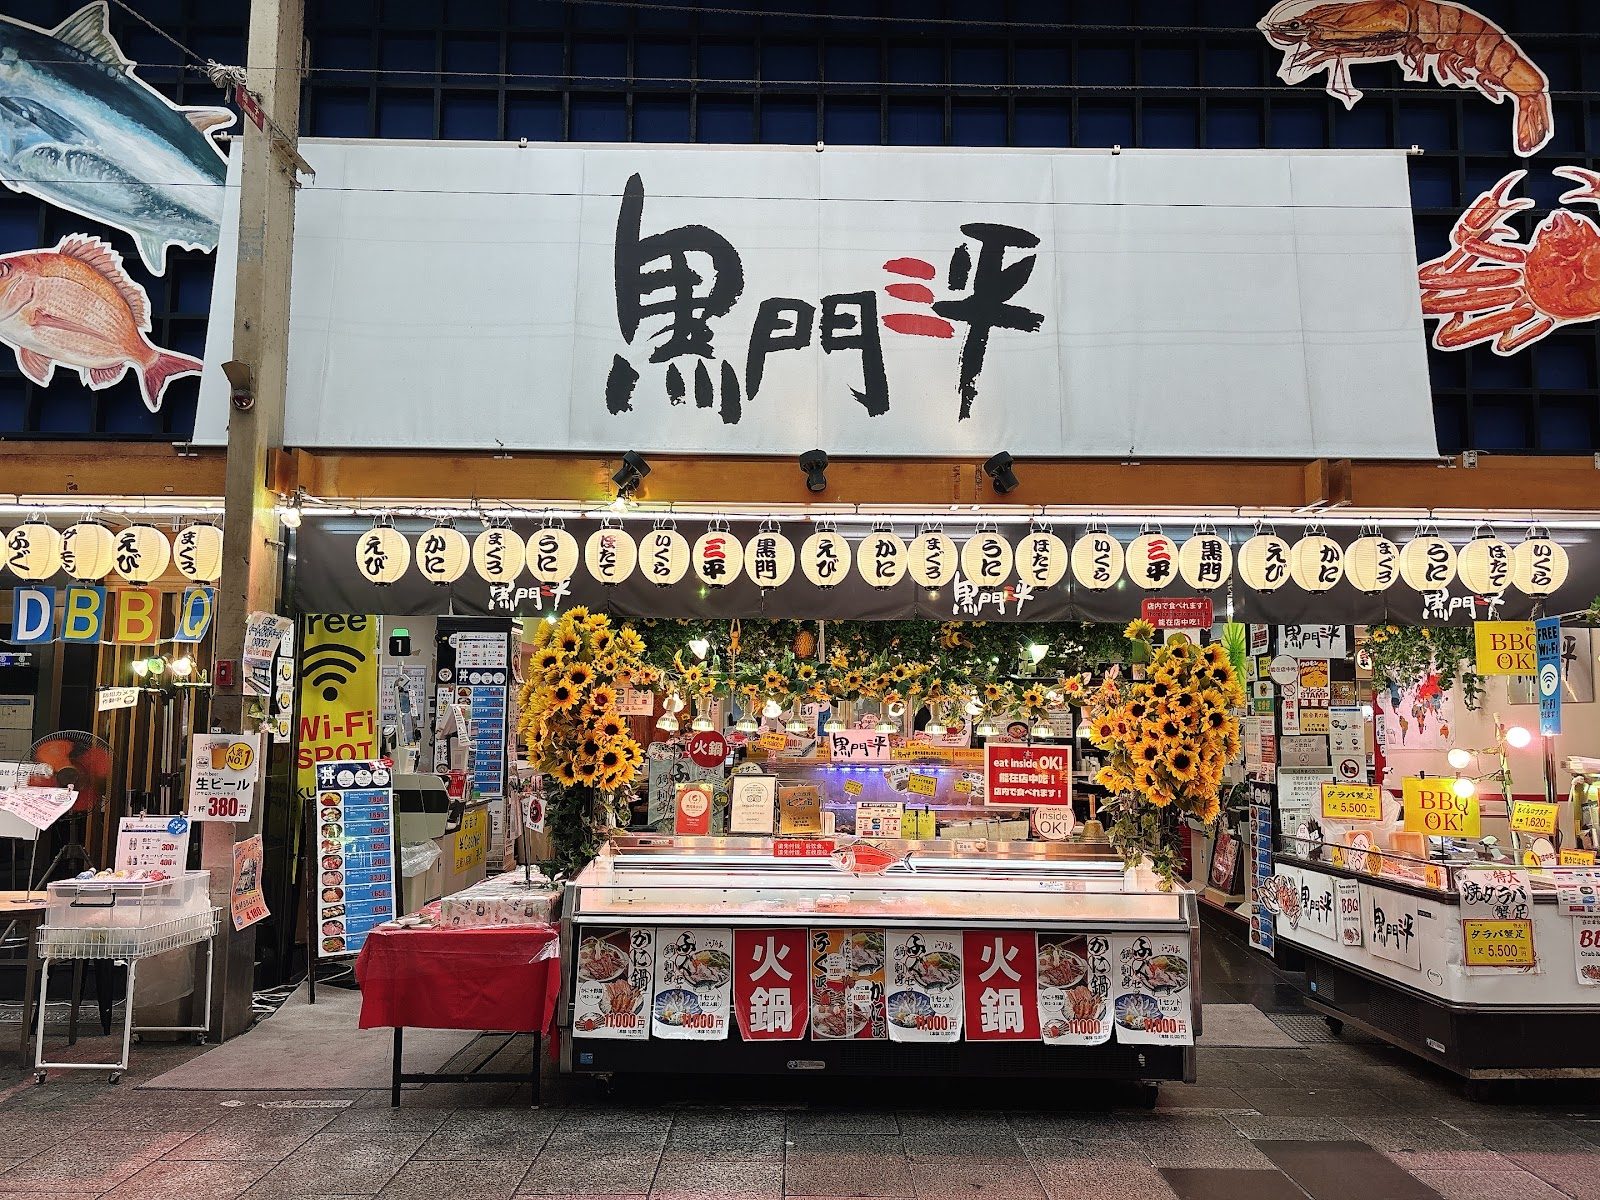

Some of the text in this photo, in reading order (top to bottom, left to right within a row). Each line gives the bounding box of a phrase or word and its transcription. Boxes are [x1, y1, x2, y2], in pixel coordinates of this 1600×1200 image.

[605, 172, 1045, 424] 黒門三平
[9, 531, 30, 571] ふぐ
[61, 528, 77, 573] サーモン
[117, 533, 141, 573] えび
[180, 531, 198, 574] まぐろ
[364, 536, 388, 575] えび
[425, 534, 446, 574] かに
[486, 532, 506, 575] まぐろ
[537, 535, 558, 572] うに
[599, 534, 616, 576] ほたて
[653, 534, 671, 576] いくら
[702, 538, 726, 580] 三平
[755, 538, 777, 580] 黒門
[816, 539, 839, 578] えび
[875, 539, 897, 578] かに
[925, 538, 944, 579] まぐろ
[981, 539, 1002, 577] うに
[1032, 539, 1050, 581] ほたて
[1093, 539, 1111, 582] いくら
[1146, 539, 1171, 582] 三平
[1198, 540, 1223, 582] 黒門
[1264, 542, 1287, 582] えび
[1318, 545, 1340, 583] かに
[1375, 542, 1398, 583] まぐろ
[1425, 543, 1450, 582] うに
[1487, 544, 1508, 586] ほたて
[1530, 544, 1552, 586] いくら
[307, 614, 367, 634] ree
[1537, 626, 1557, 641] FREE
[1496, 652, 1536, 670] OK!
[299, 710, 374, 743] Wi-Fi
[833, 733, 887, 757] 黒門三平
[298, 741, 373, 769] SPOT
[693, 739, 724, 757] 火鍋
[993, 756, 1063, 770] eat inside OK!
[196, 777, 250, 791] 生ビール
[1418, 790, 1469, 815] BBQ
[208, 797, 238, 816] 380
[1040, 811, 1067, 820] inside
[1341, 803, 1367, 813] 5,500
[1424, 812, 1463, 832] OK!
[1525, 817, 1546, 828] 1,620
[1040, 820, 1067, 835] OK!
[1301, 876, 1332, 923] 黒門三平
[1341, 898, 1359, 913] BBQ
[1463, 880, 1527, 905] 焼タラバ
[1373, 896, 1414, 953] 黒門三平
[1471, 929, 1526, 939] タラバ蟹足
[630, 930, 651, 992] かに鍋
[1088, 936, 1111, 998] かに鍋
[1488, 944, 1518, 957] 5,500
[749, 936, 793, 1033] 火鍋
[978, 937, 1024, 1033] 火鍋
[1158, 998, 1181, 1006] 1セット
[605, 1014, 636, 1028] 11,000
[1069, 1019, 1100, 1034] 11,000
